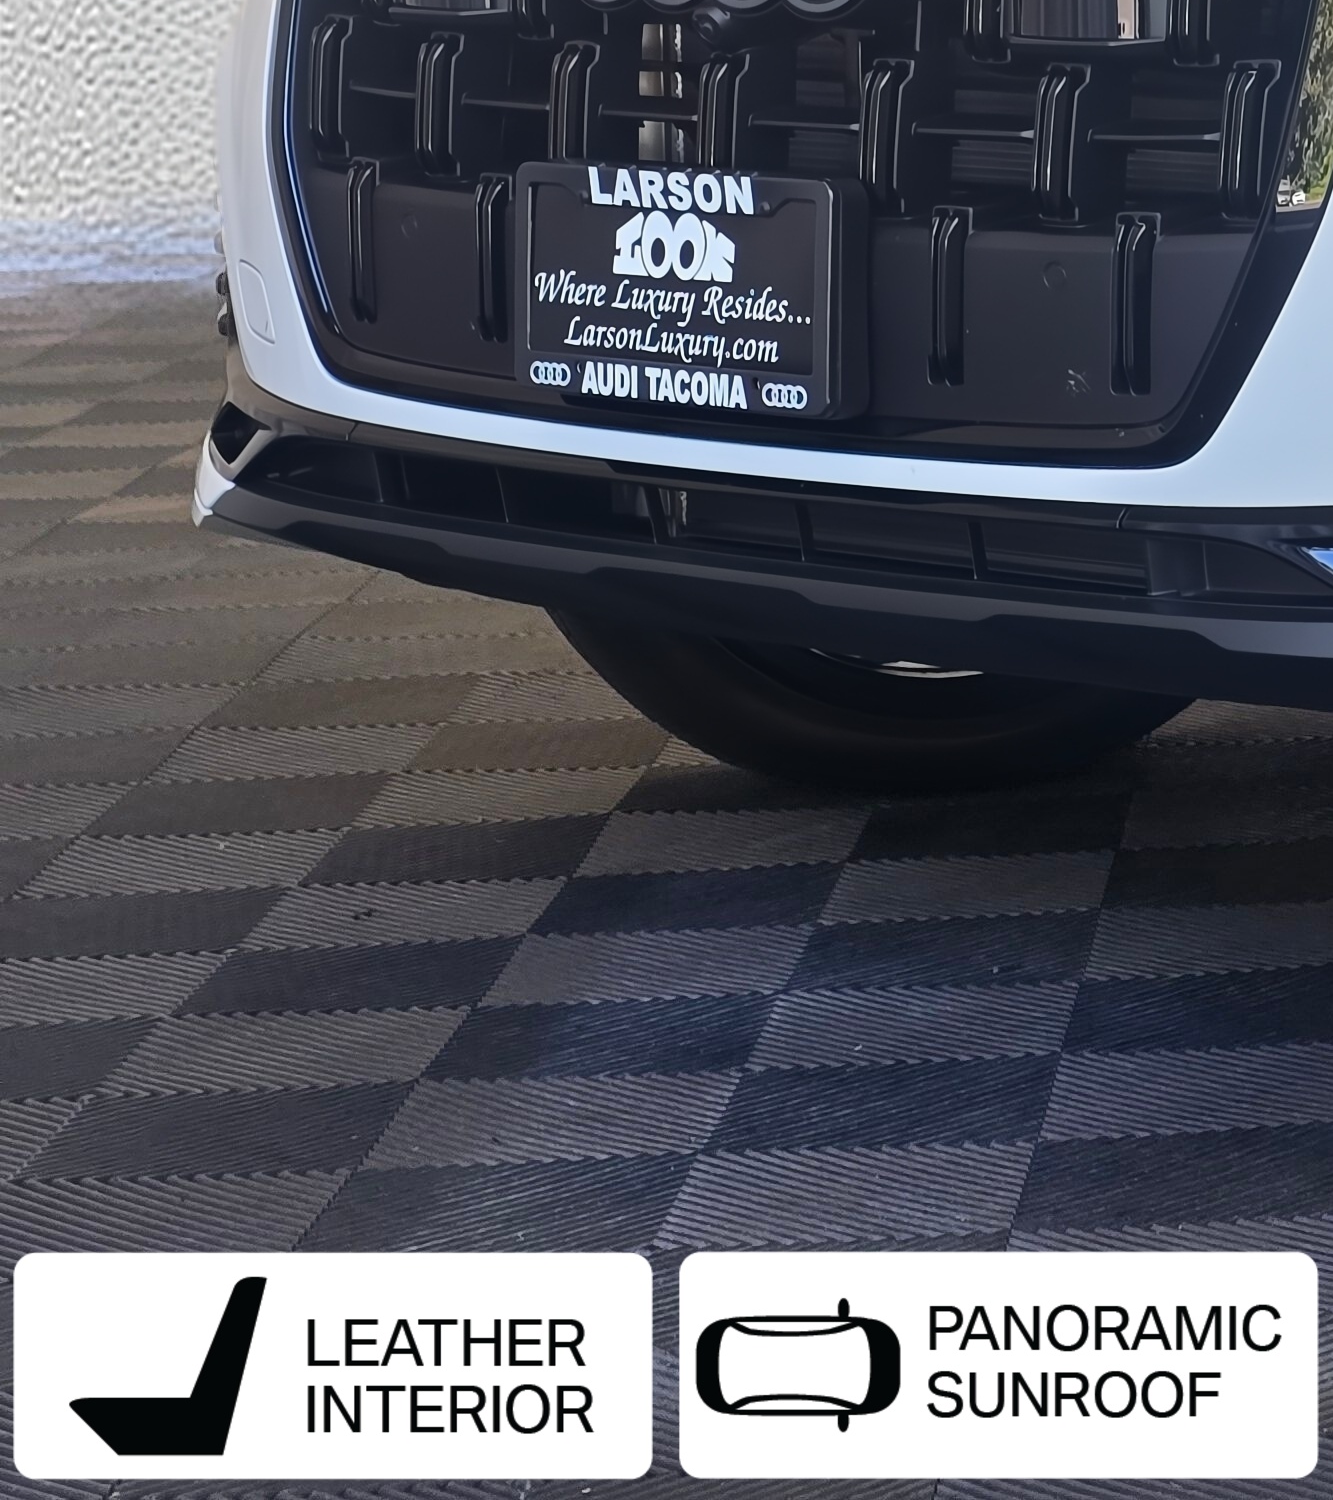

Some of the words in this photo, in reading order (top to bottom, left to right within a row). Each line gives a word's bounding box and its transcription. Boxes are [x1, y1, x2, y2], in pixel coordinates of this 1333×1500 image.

[588, 165, 755, 215] LARSON
[534, 269, 607, 307] Where
[611, 279, 696, 327] Luxury
[702, 286, 811, 325] Resides...
[564, 316, 779, 367] LarsonLuxury.com
[581, 361, 639, 398] AUDI
[644, 366, 748, 409] TACOMA
